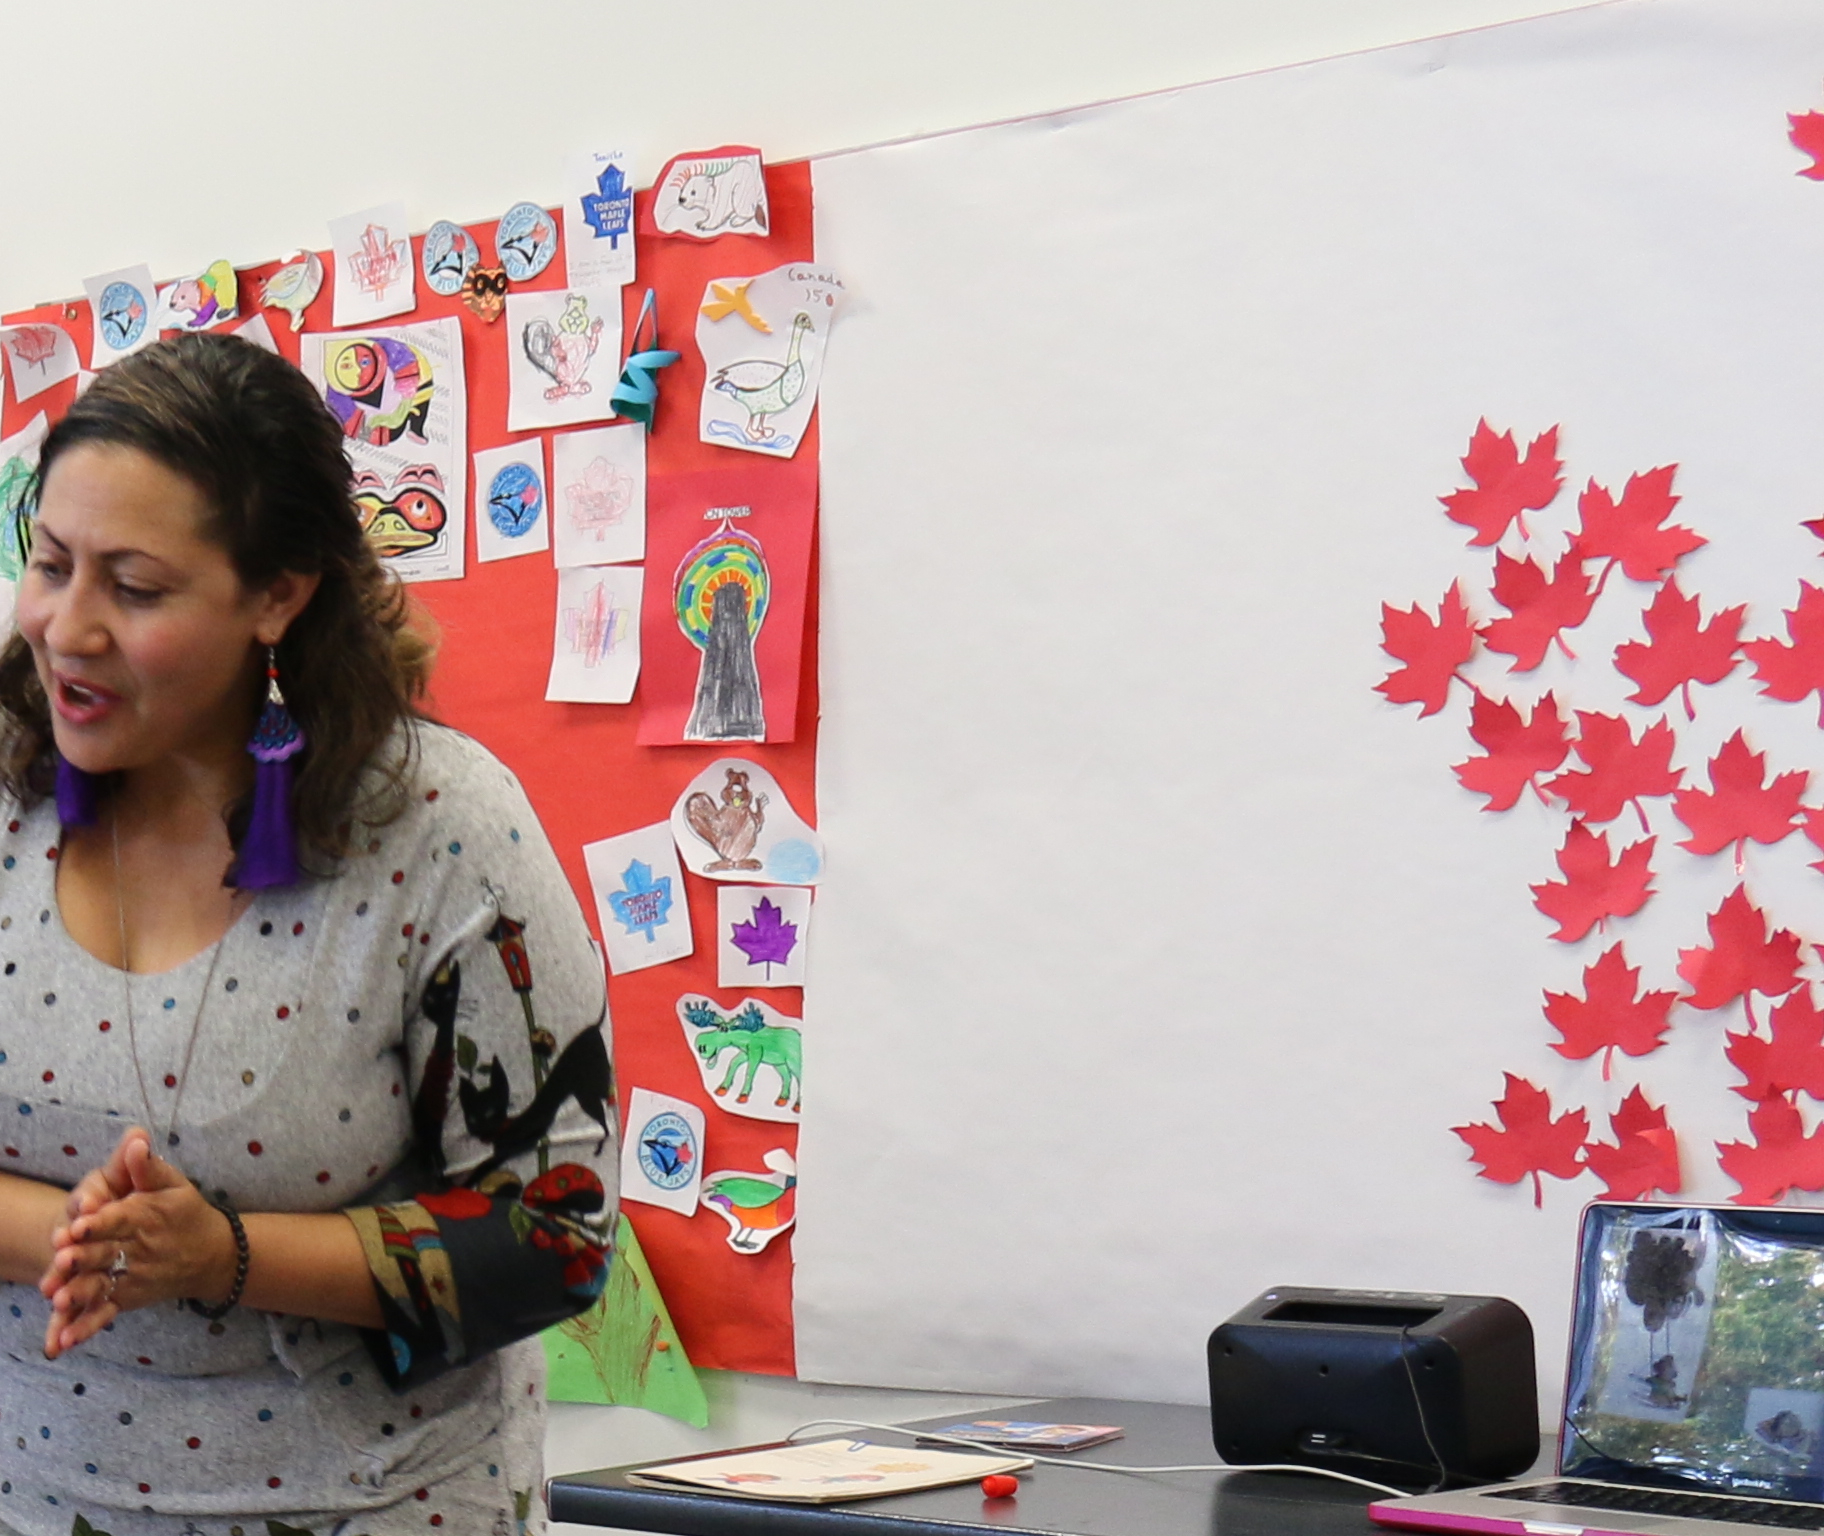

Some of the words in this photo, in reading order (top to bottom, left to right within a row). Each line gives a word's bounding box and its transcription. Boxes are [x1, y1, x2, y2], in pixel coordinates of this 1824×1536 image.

[593, 197, 630, 213] TORONTO
[599, 208, 627, 222] MAPLE
[602, 218, 625, 231] LEAFS
[788, 267, 845, 290] Canada
[644, 1118, 687, 1137] TORONTO
[640, 1154, 665, 1184] BLUE
[668, 1167, 692, 1187] JAYS
